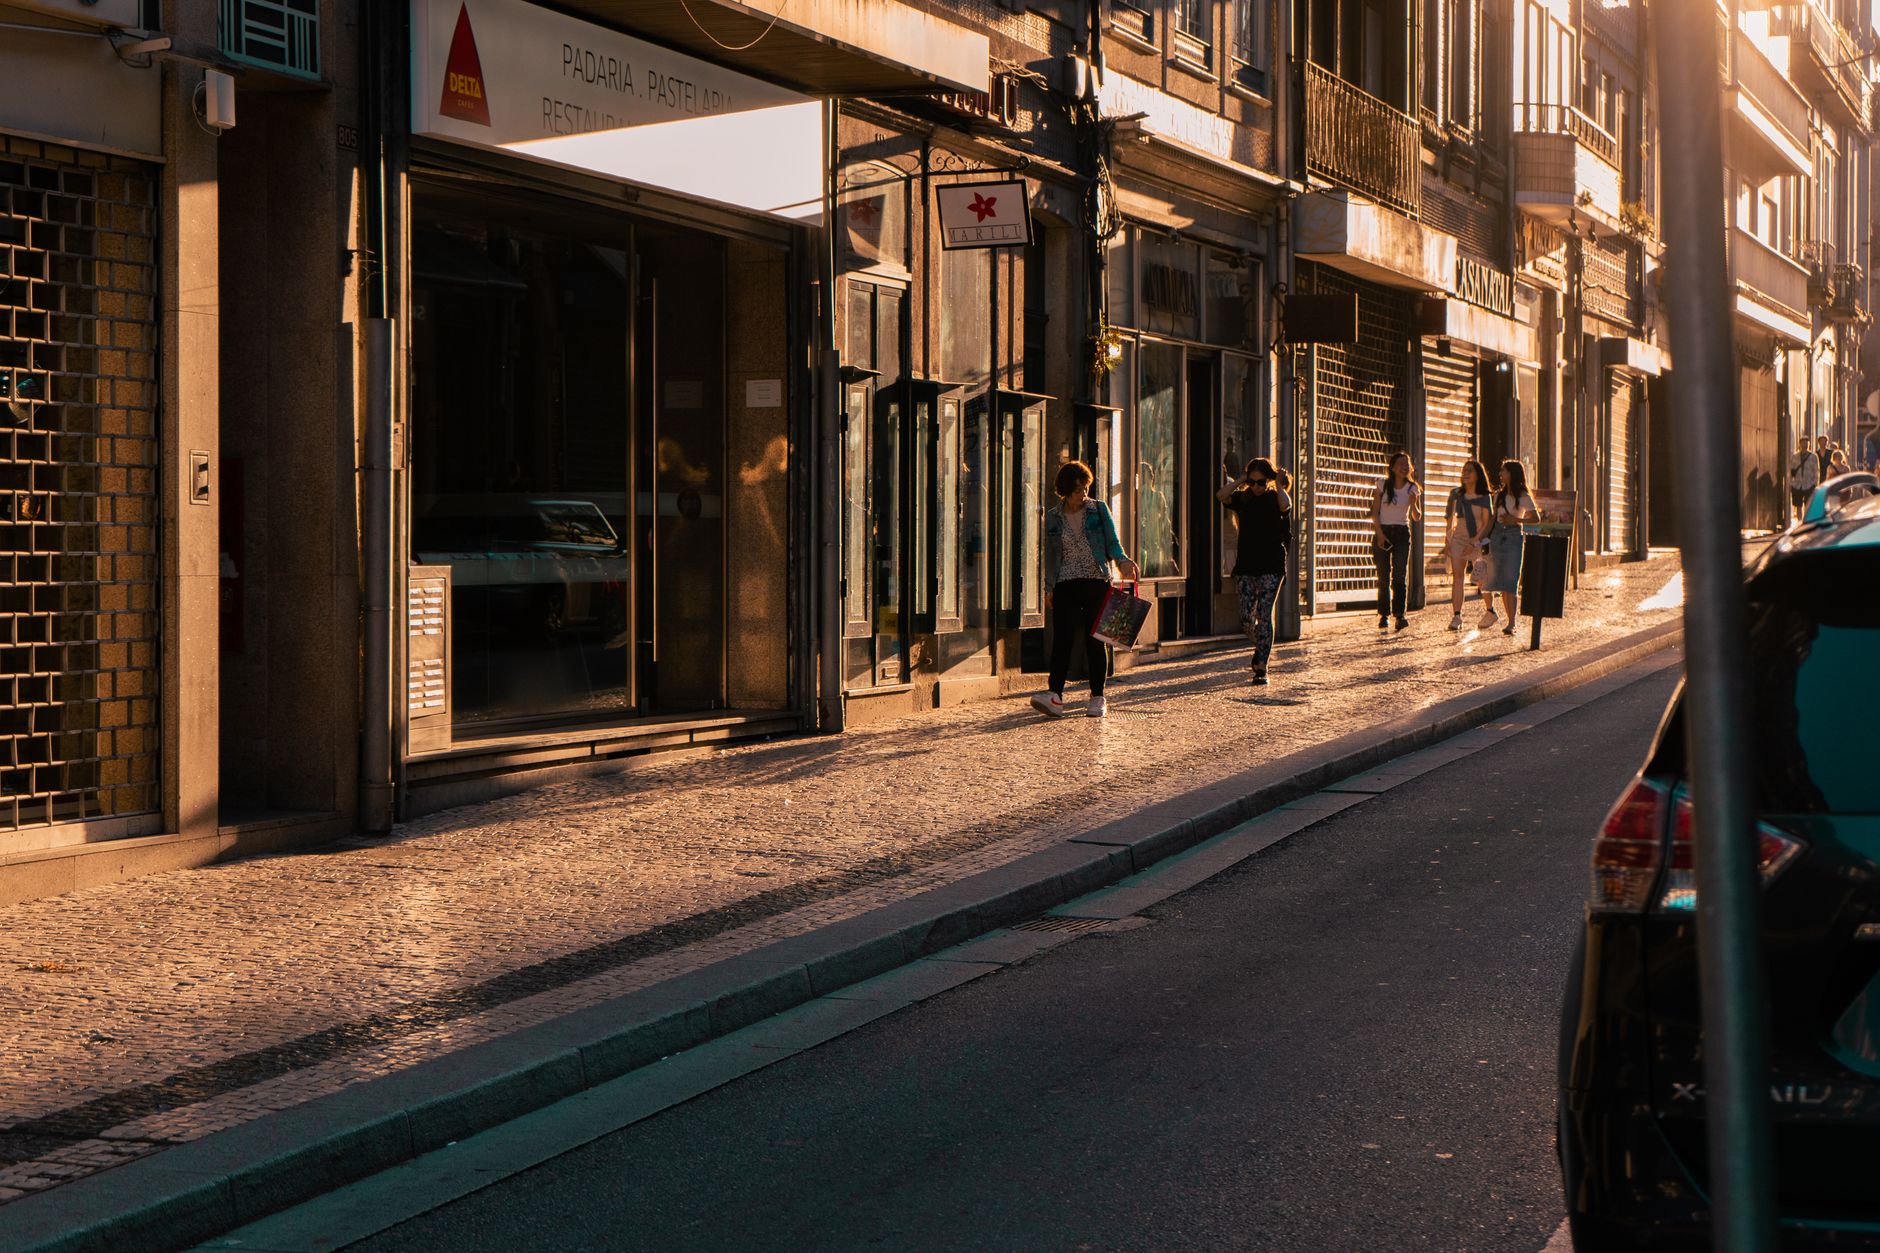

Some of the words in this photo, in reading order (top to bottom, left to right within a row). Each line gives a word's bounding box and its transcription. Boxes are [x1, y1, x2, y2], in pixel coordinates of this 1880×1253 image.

[563, 44, 634, 96] PADARIA
[449, 72, 482, 99] DELTA
[338, 126, 358, 148] 805
[948, 225, 1022, 241] MARILU
